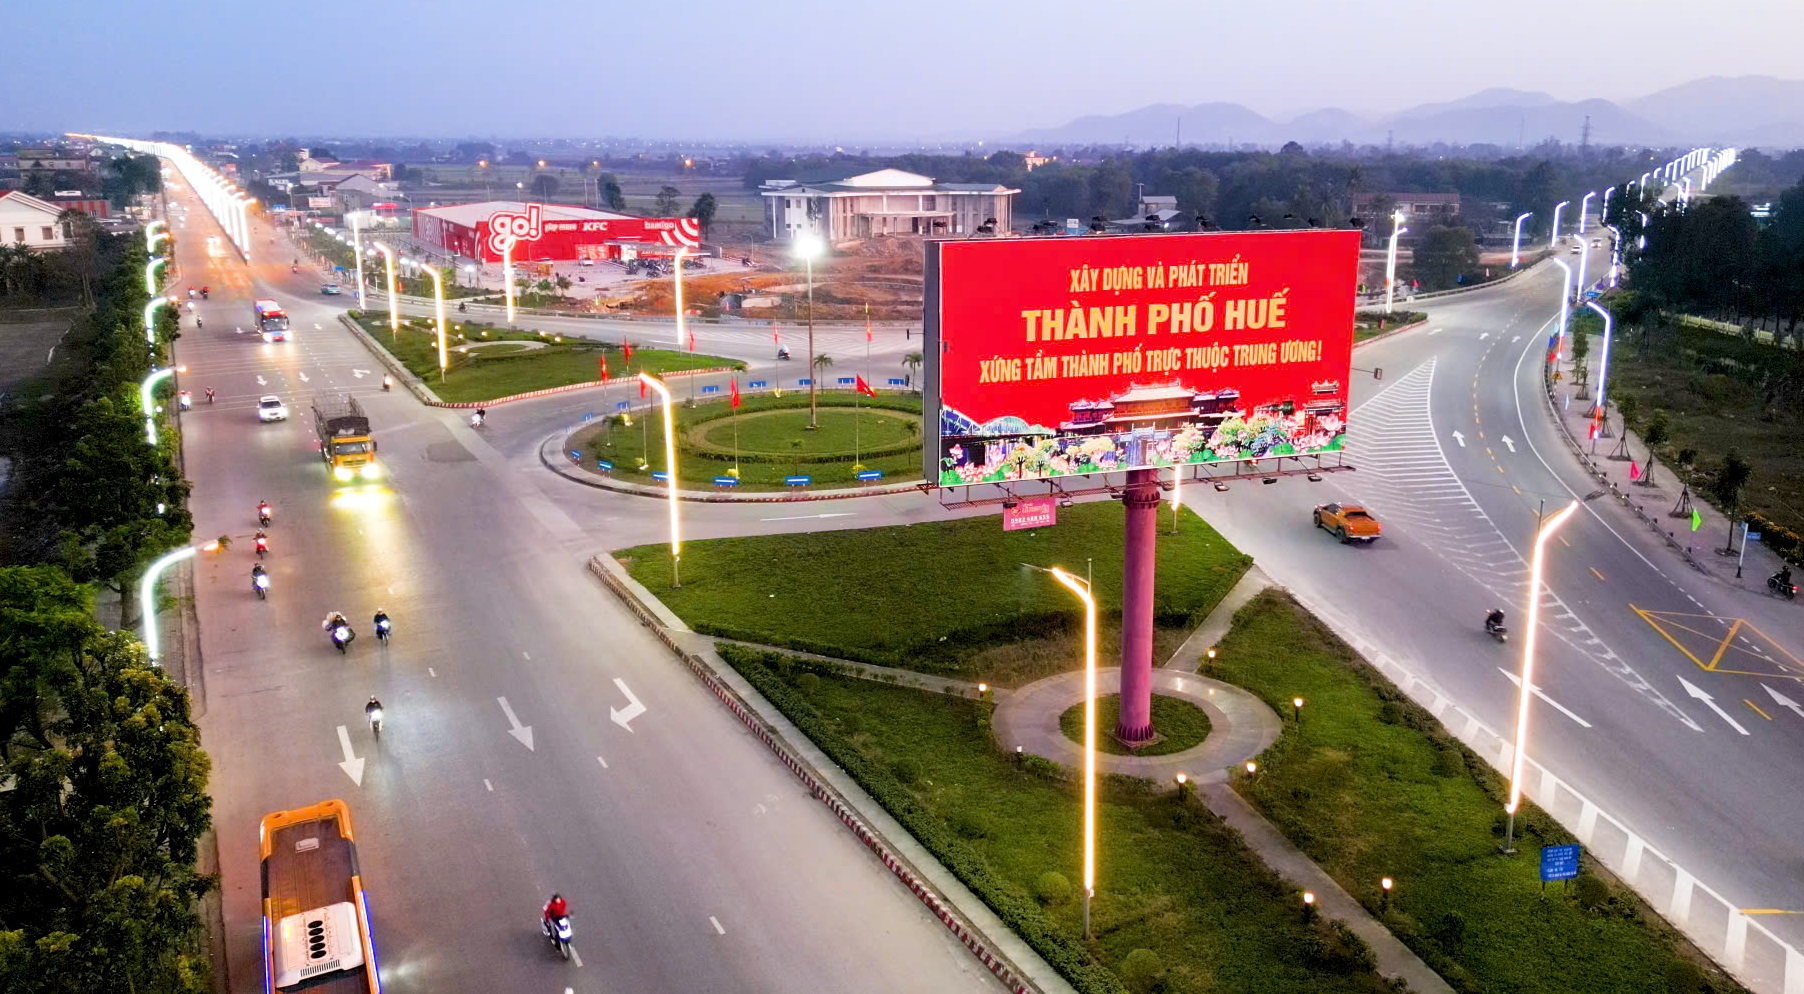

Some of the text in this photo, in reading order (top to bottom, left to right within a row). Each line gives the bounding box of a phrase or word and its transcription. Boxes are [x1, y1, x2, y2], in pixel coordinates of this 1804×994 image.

[489, 203, 542, 254] go!
[583, 222, 608, 231] KFC
[1069, 254, 1249, 296] XÂY DỰNG VÀ PHÁT TRIỂN
[1021, 287, 1291, 342] THÀNH PHỐ HUẾ
[979, 339, 1323, 384] XỨNG TẦM THÀNH PHỐ TRỰC THUỘC TRUNG ƯƠNG!
